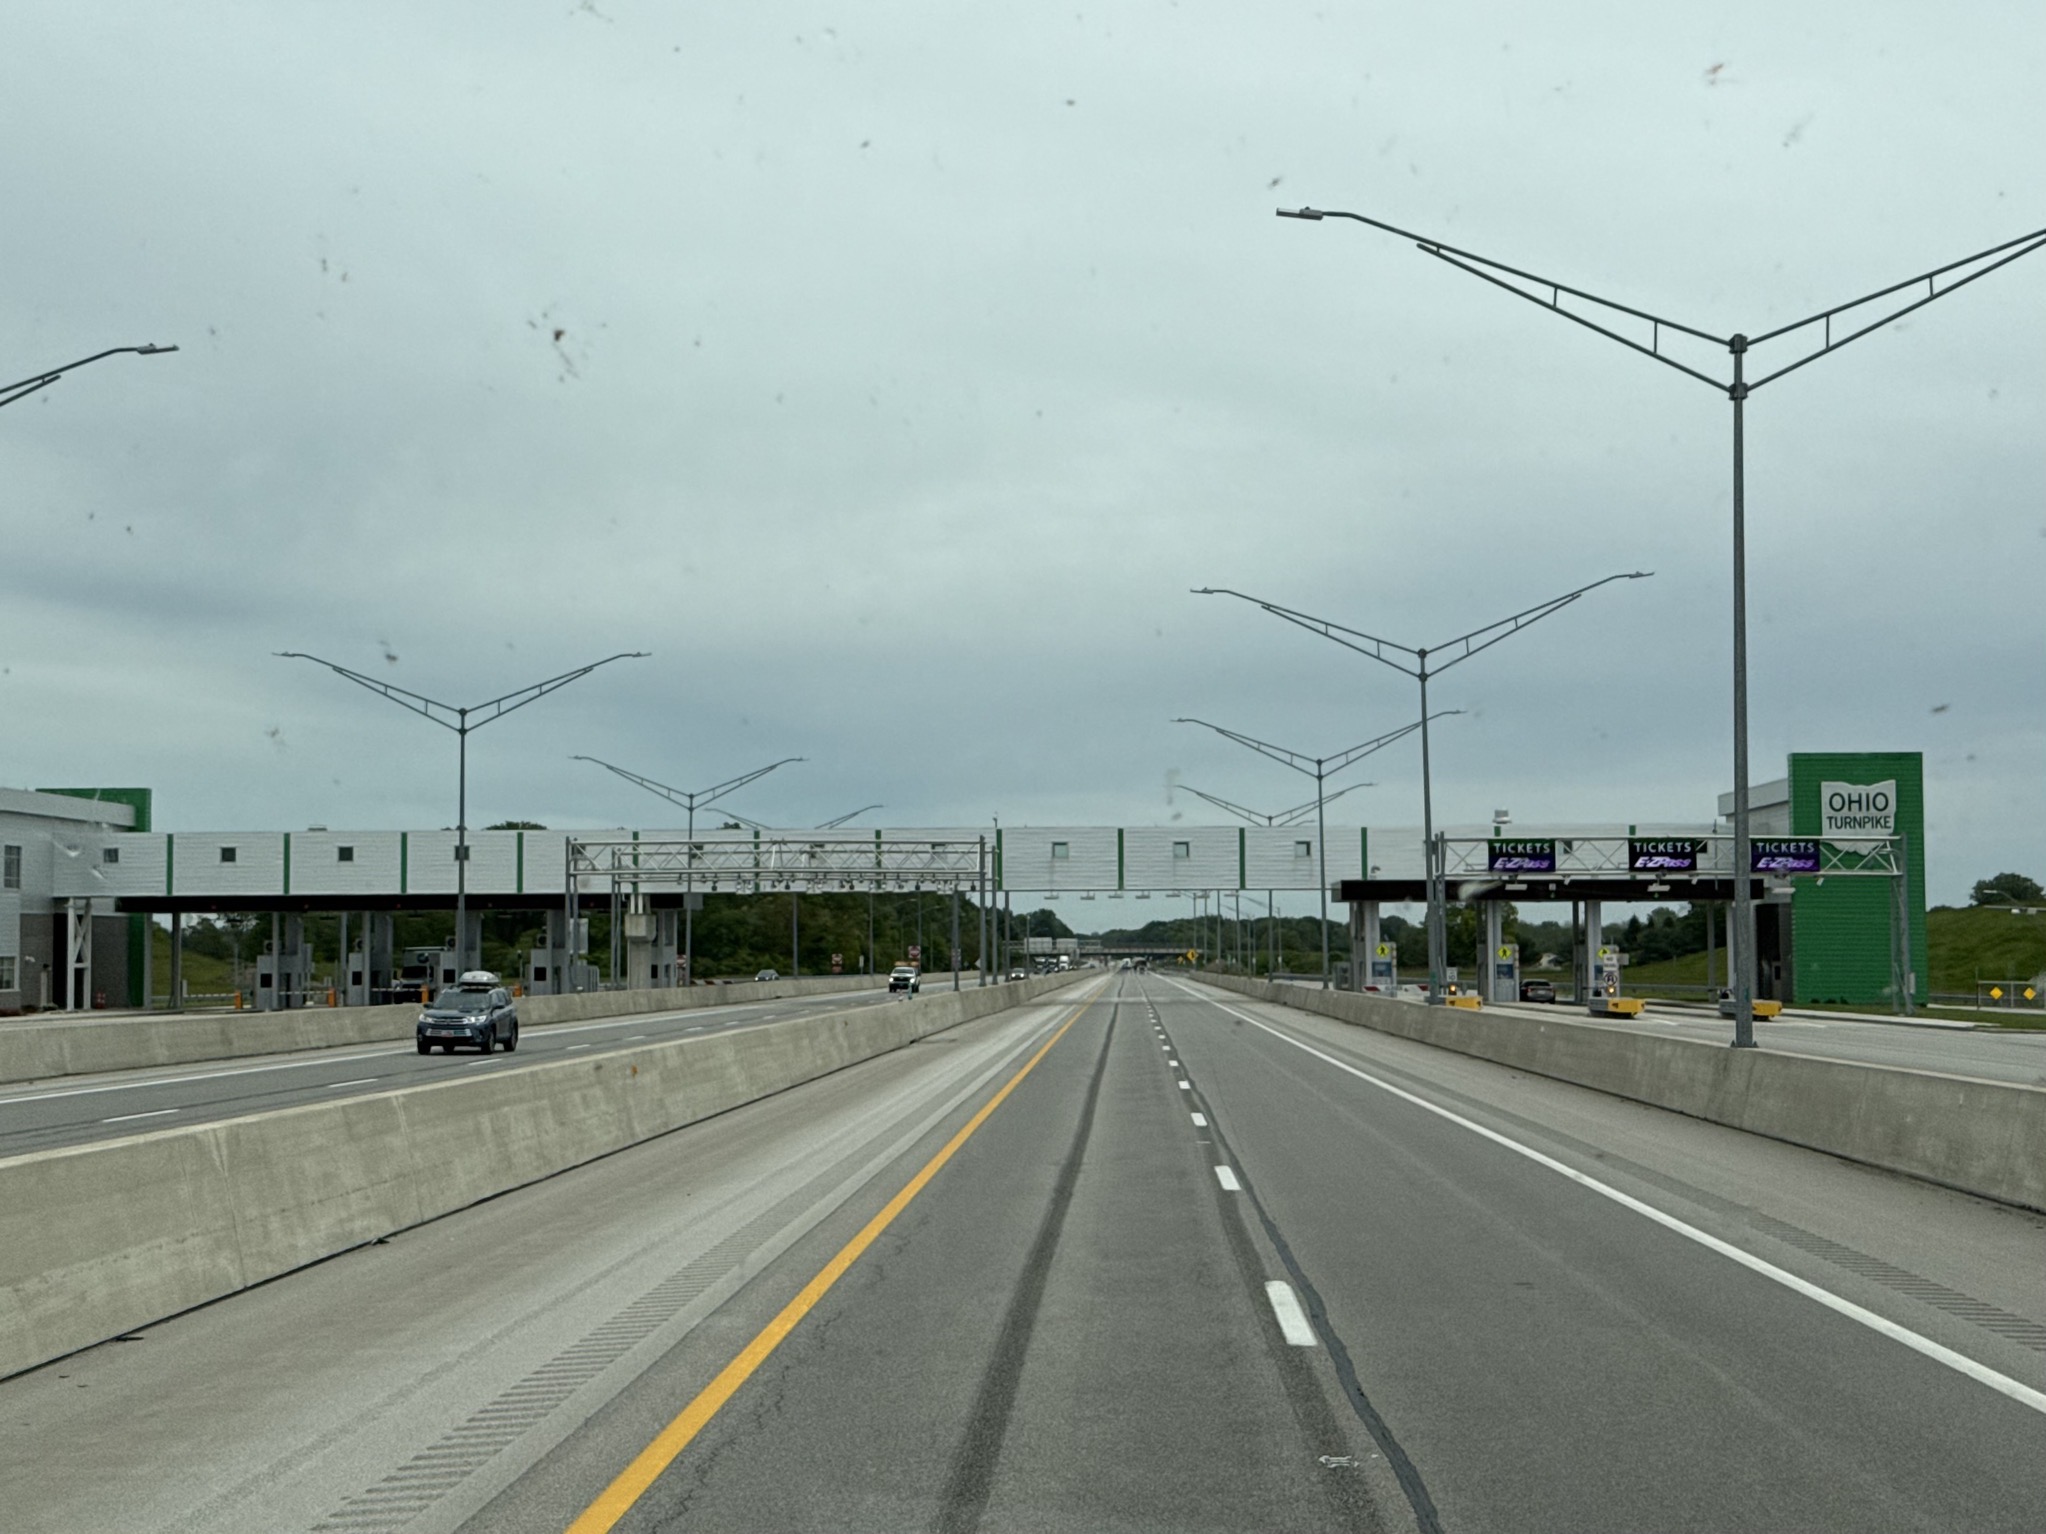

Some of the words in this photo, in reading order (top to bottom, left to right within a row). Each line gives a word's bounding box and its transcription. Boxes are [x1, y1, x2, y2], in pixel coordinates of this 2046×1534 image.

[1829, 792, 1889, 812] OHIO
[1826, 815, 1892, 830] TURNPIKE
[1494, 843, 1551, 854] TICKETS
[1634, 842, 1691, 853] TICKETS
[1756, 842, 1815, 853] TICKETS
